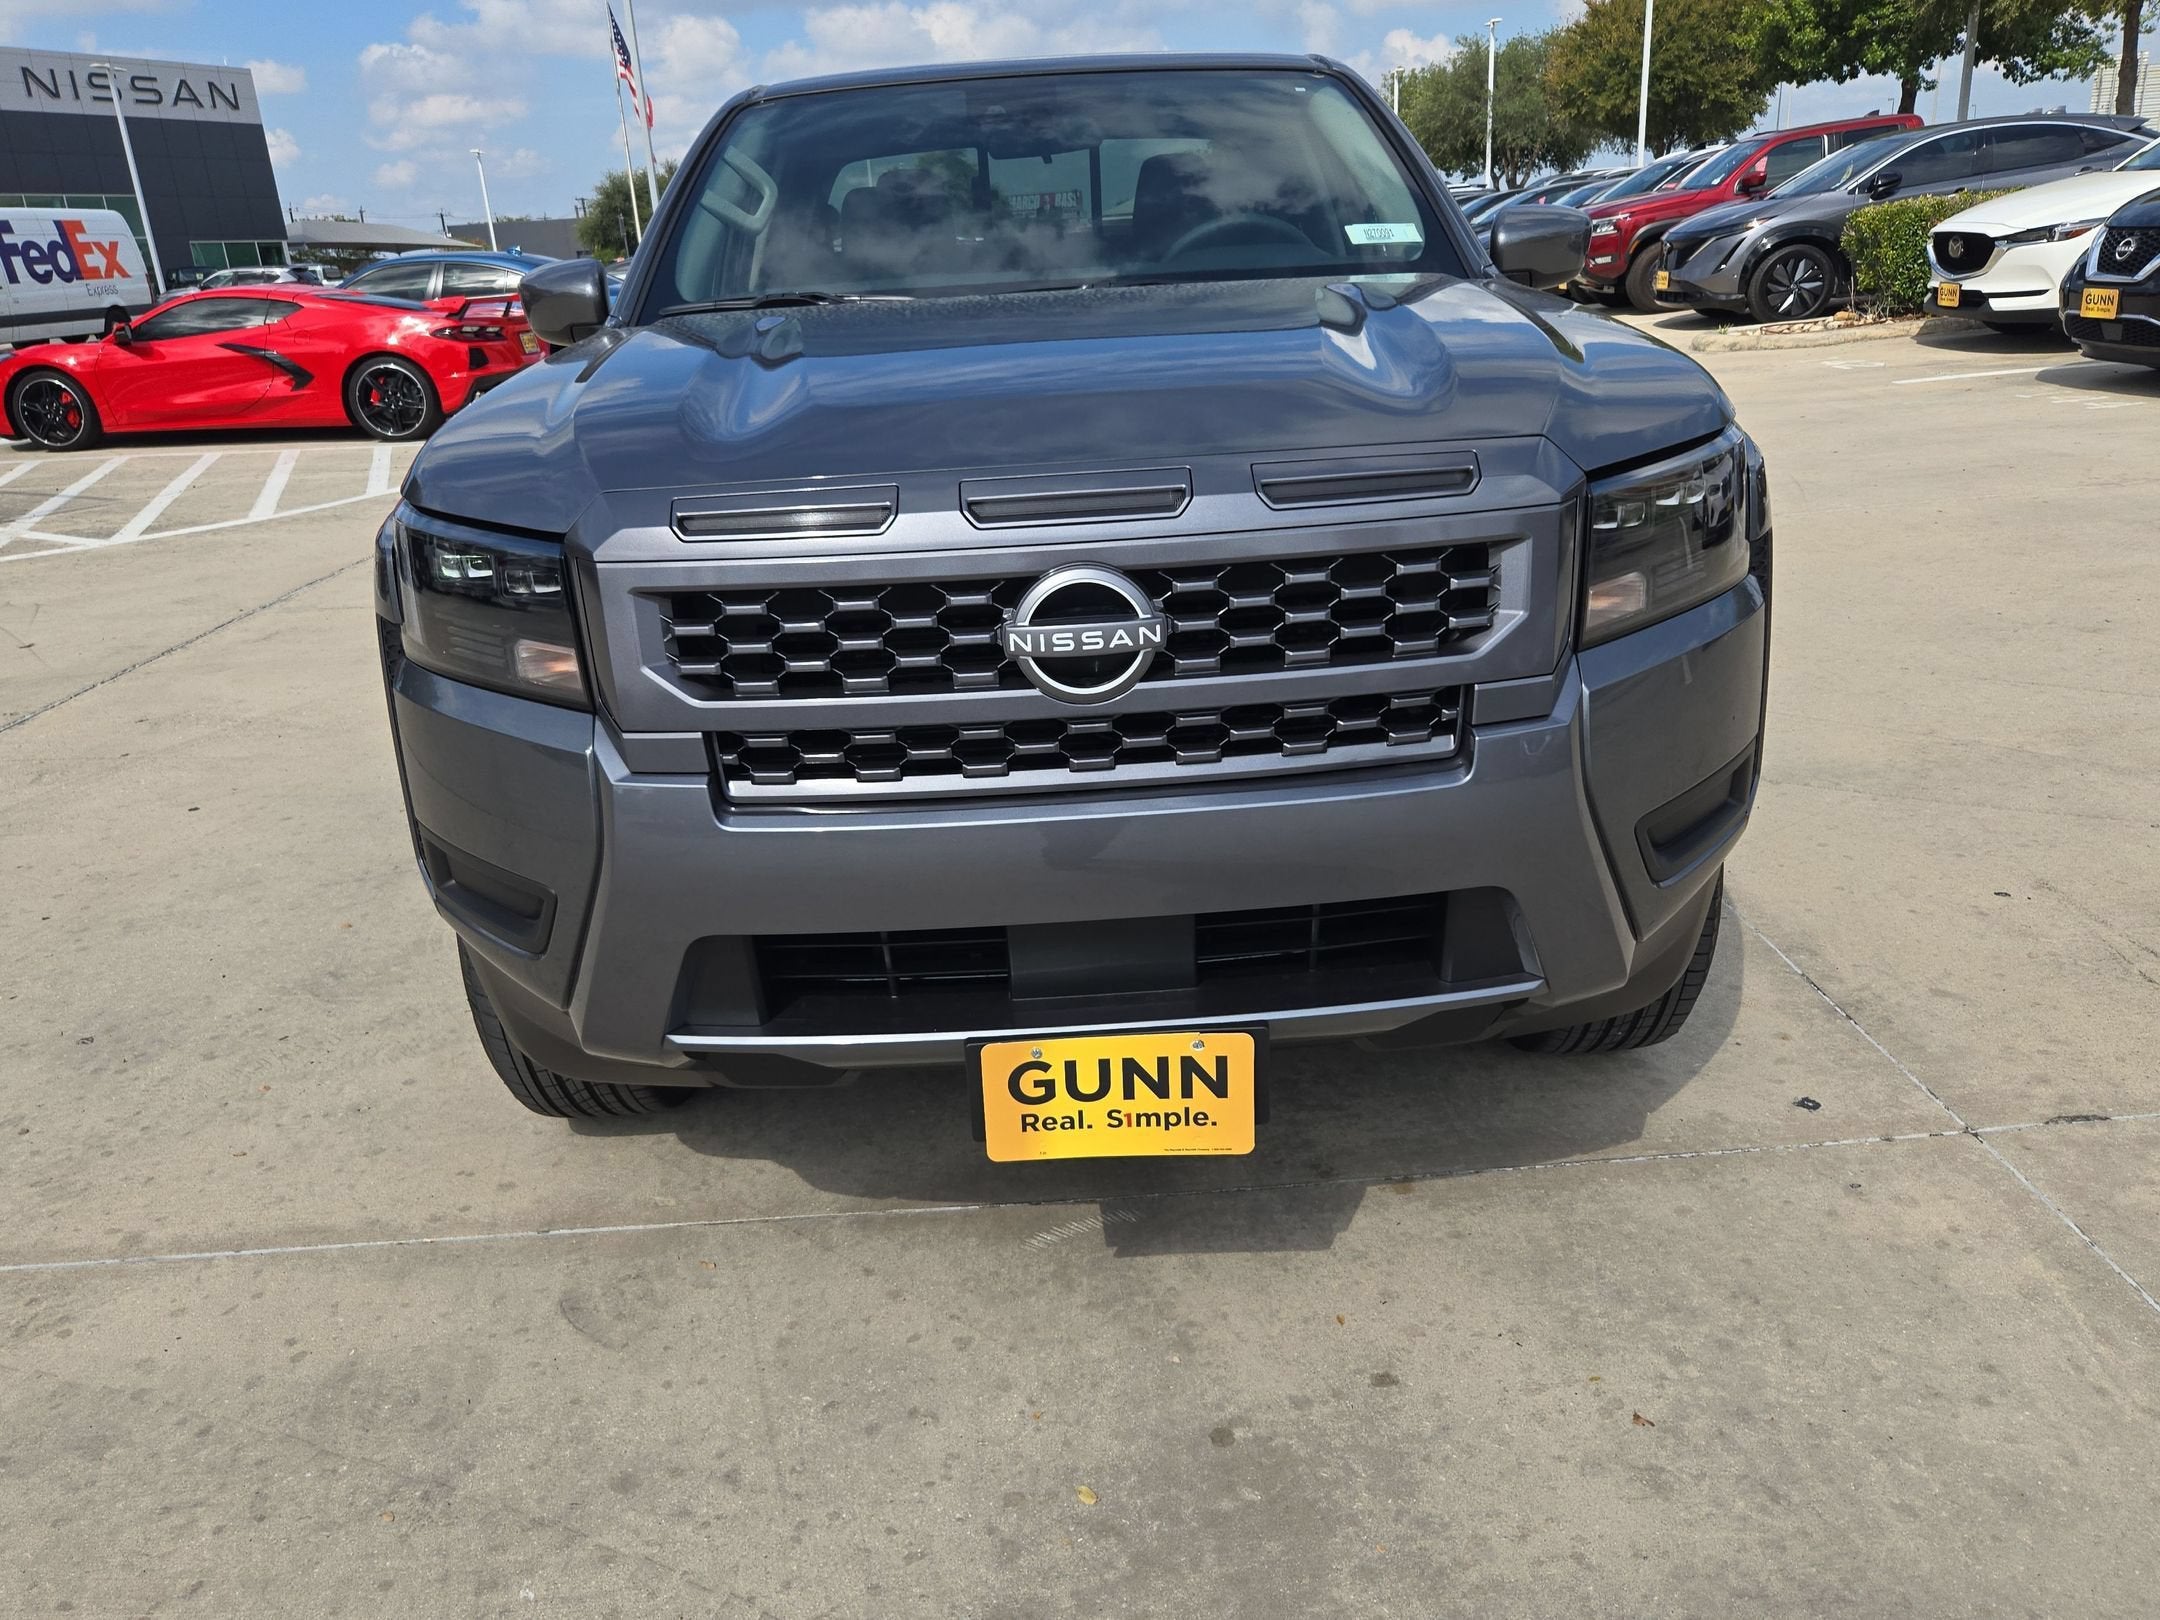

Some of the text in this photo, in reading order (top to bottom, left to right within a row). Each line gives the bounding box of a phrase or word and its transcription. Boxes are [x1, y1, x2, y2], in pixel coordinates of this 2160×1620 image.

[21, 66, 240, 111] NISSAN
[0, 219, 132, 284] FedEx
[86, 284, 119, 298] Express
[1940, 287, 1957, 297] GUNN
[2085, 293, 2115, 306] GUNN
[1009, 624, 1161, 652] NISSAN
[1007, 1055, 1229, 1106] GUNN
[1021, 1110, 1093, 1133] Real.
